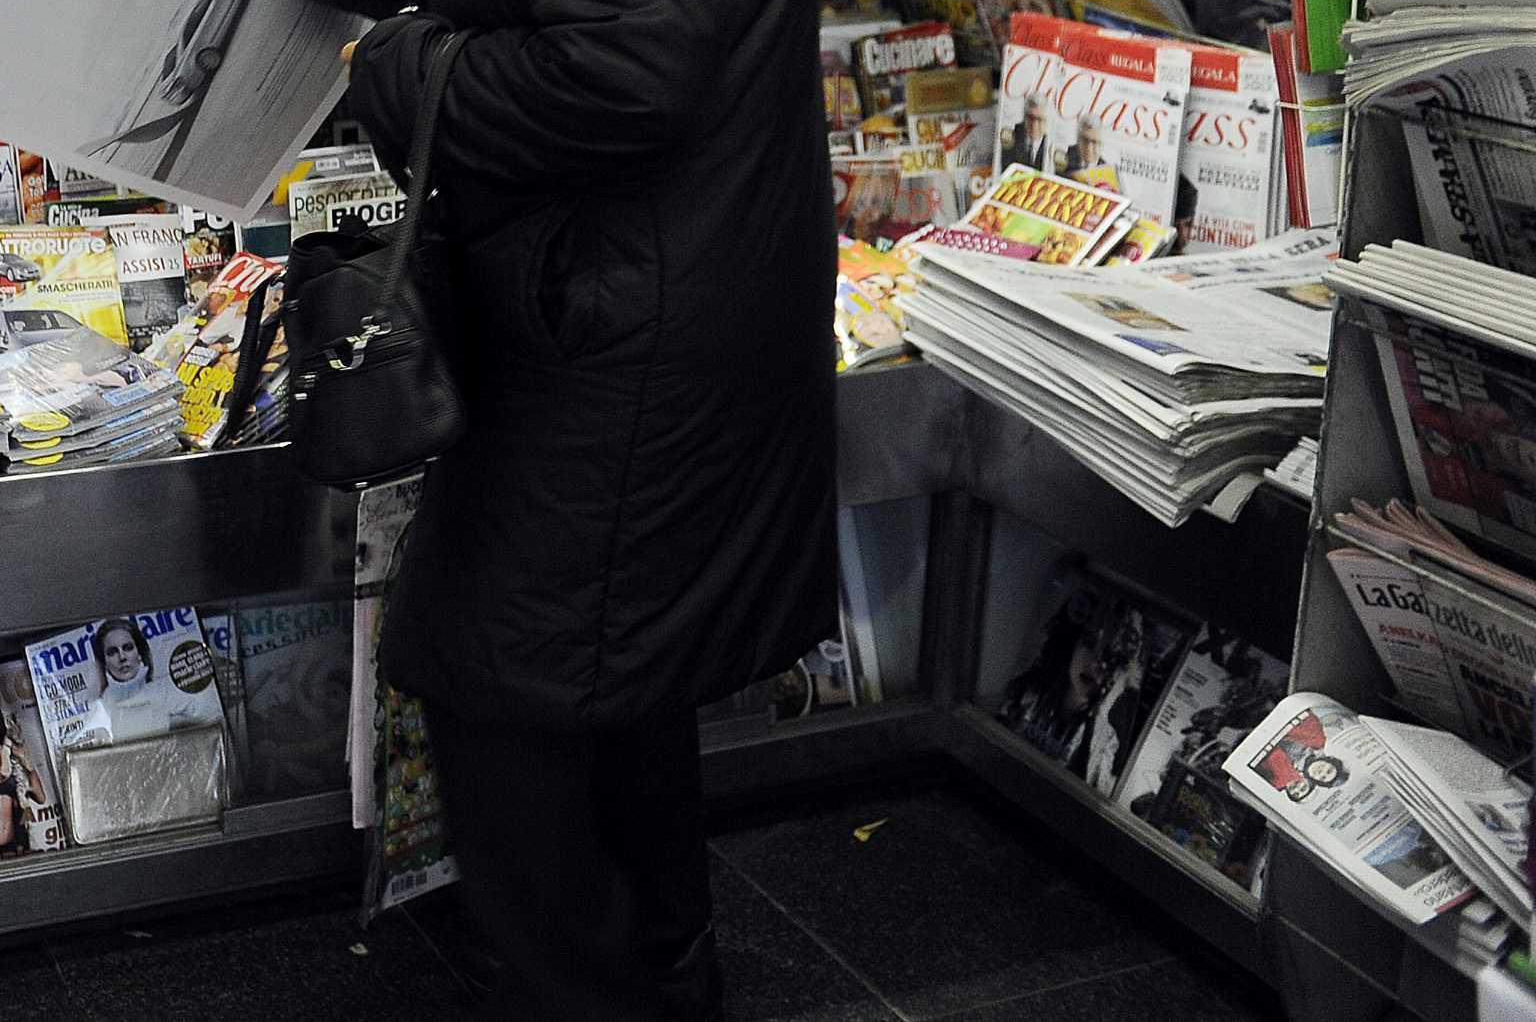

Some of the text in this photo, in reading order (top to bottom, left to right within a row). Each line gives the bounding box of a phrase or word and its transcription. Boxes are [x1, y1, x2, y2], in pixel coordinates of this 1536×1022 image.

[1111, 52, 1155, 75] REGALA
[1056, 70, 1169, 143] Class
[122, 257, 180, 275] ASSISI 25
